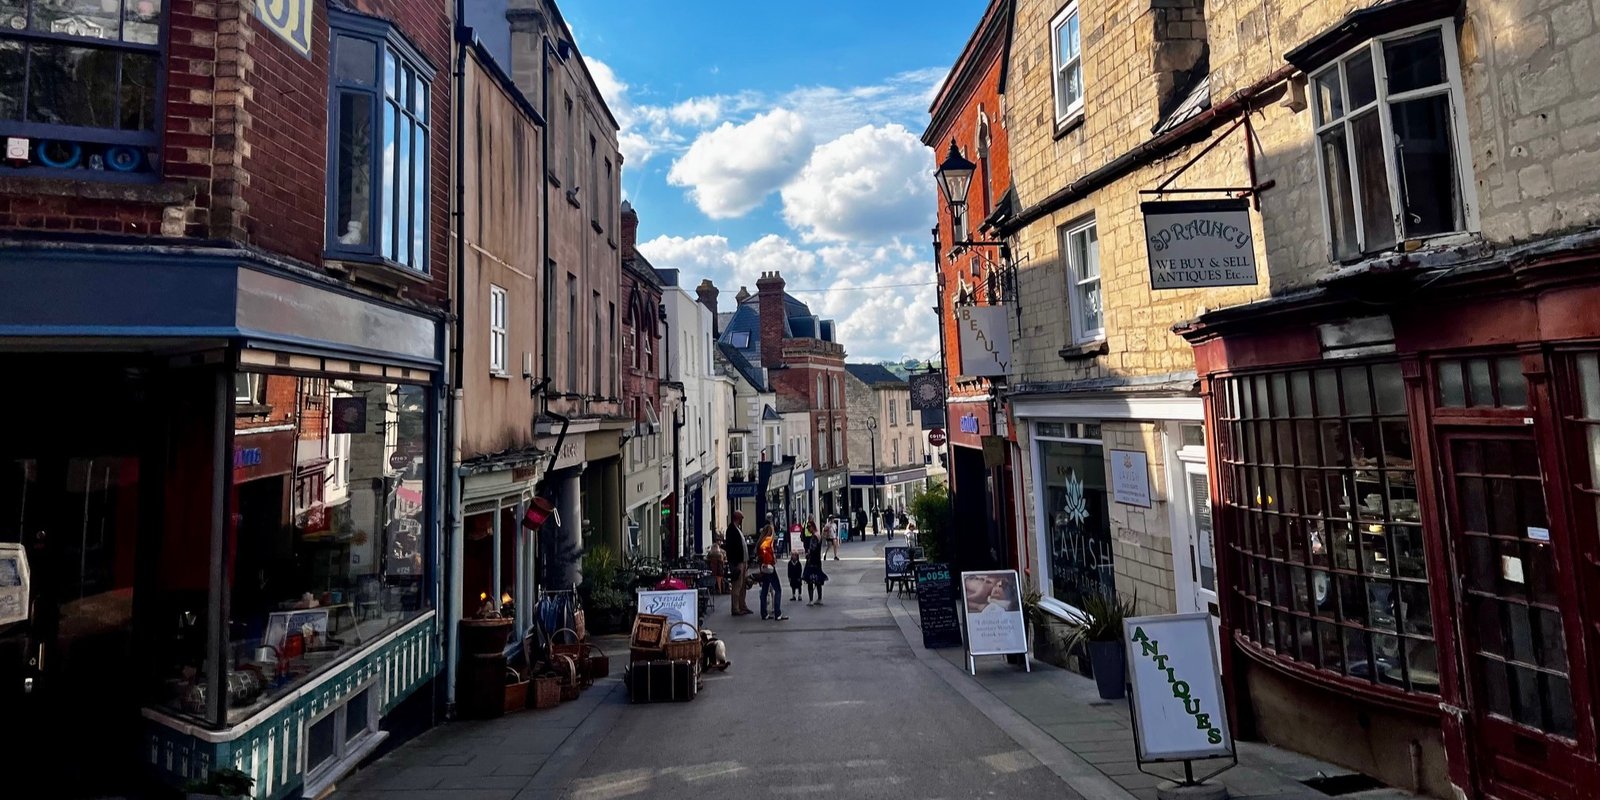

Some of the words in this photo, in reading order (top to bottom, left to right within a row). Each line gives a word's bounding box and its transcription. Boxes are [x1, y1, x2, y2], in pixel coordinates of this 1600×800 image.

[1150, 219, 1250, 252] SPRAUNCY
[1156, 259, 1177, 270] WE
[1180, 258, 1206, 269] BUY
[1209, 257, 1221, 268] &
[1223, 256, 1250, 268] SELL
[1156, 270, 1222, 283] ANTIQUES
[963, 309, 1008, 373] BEAUTY
[1051, 527, 1112, 577] LAVISH
[1081, 575, 1113, 598] therapy
[1131, 626, 1222, 744] ANTIQUES
